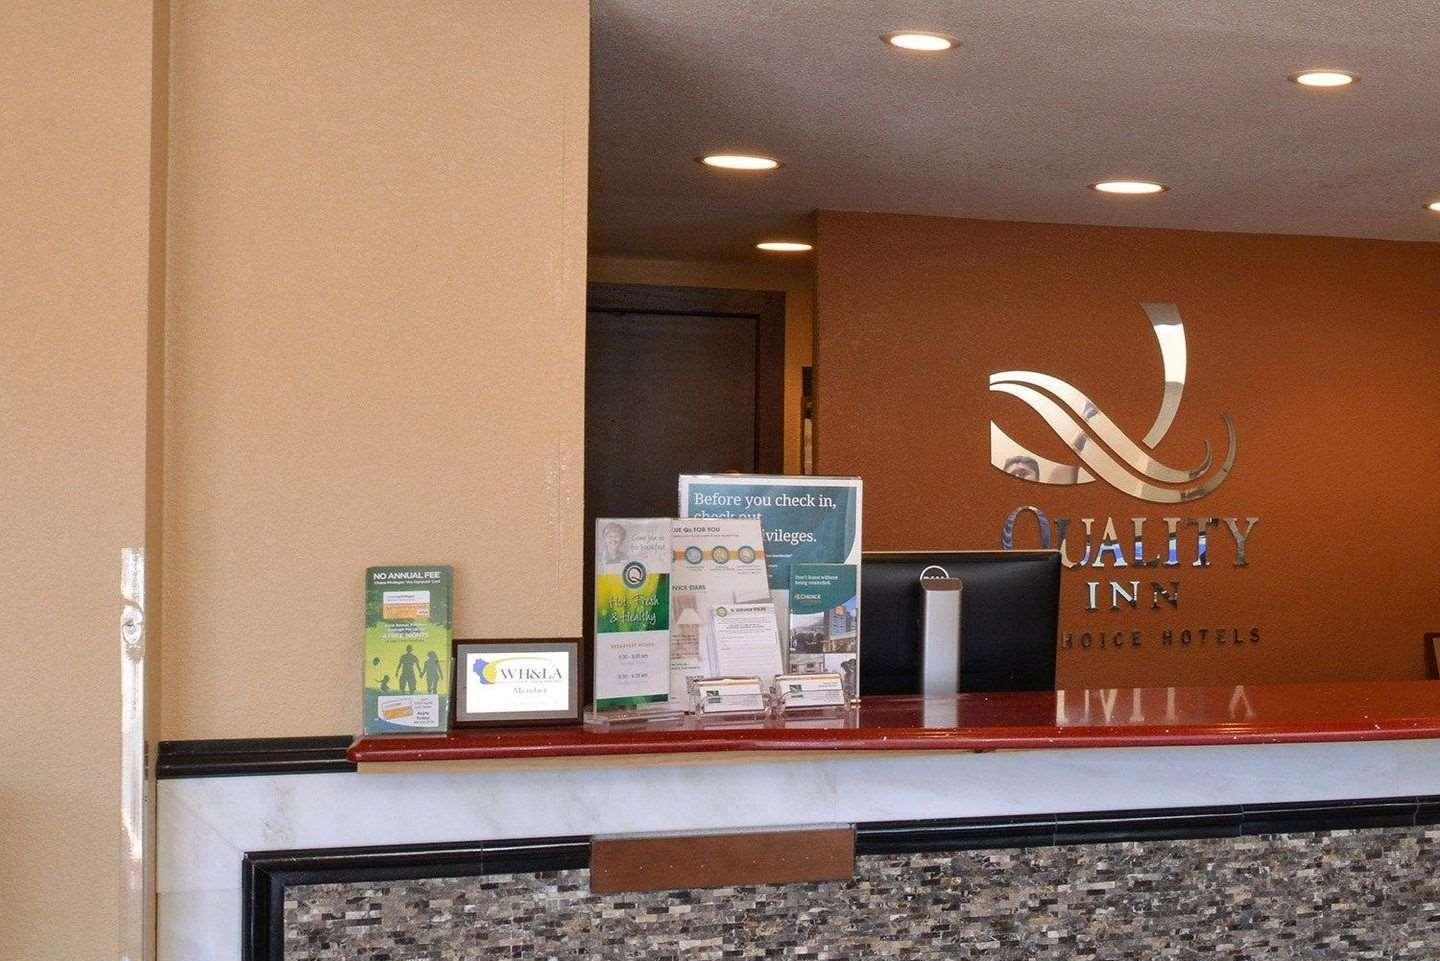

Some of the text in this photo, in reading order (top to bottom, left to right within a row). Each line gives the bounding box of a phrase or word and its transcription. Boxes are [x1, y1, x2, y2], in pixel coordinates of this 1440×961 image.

[694, 492, 837, 510] Before you check in,
[762, 528, 817, 545] ivileges.
[1002, 505, 1260, 568] QUALITY
[373, 571, 441, 580] NO ANNUAL FEE
[1086, 580, 1181, 611] INN
[1062, 628, 1261, 650] HOICE HOTELS
